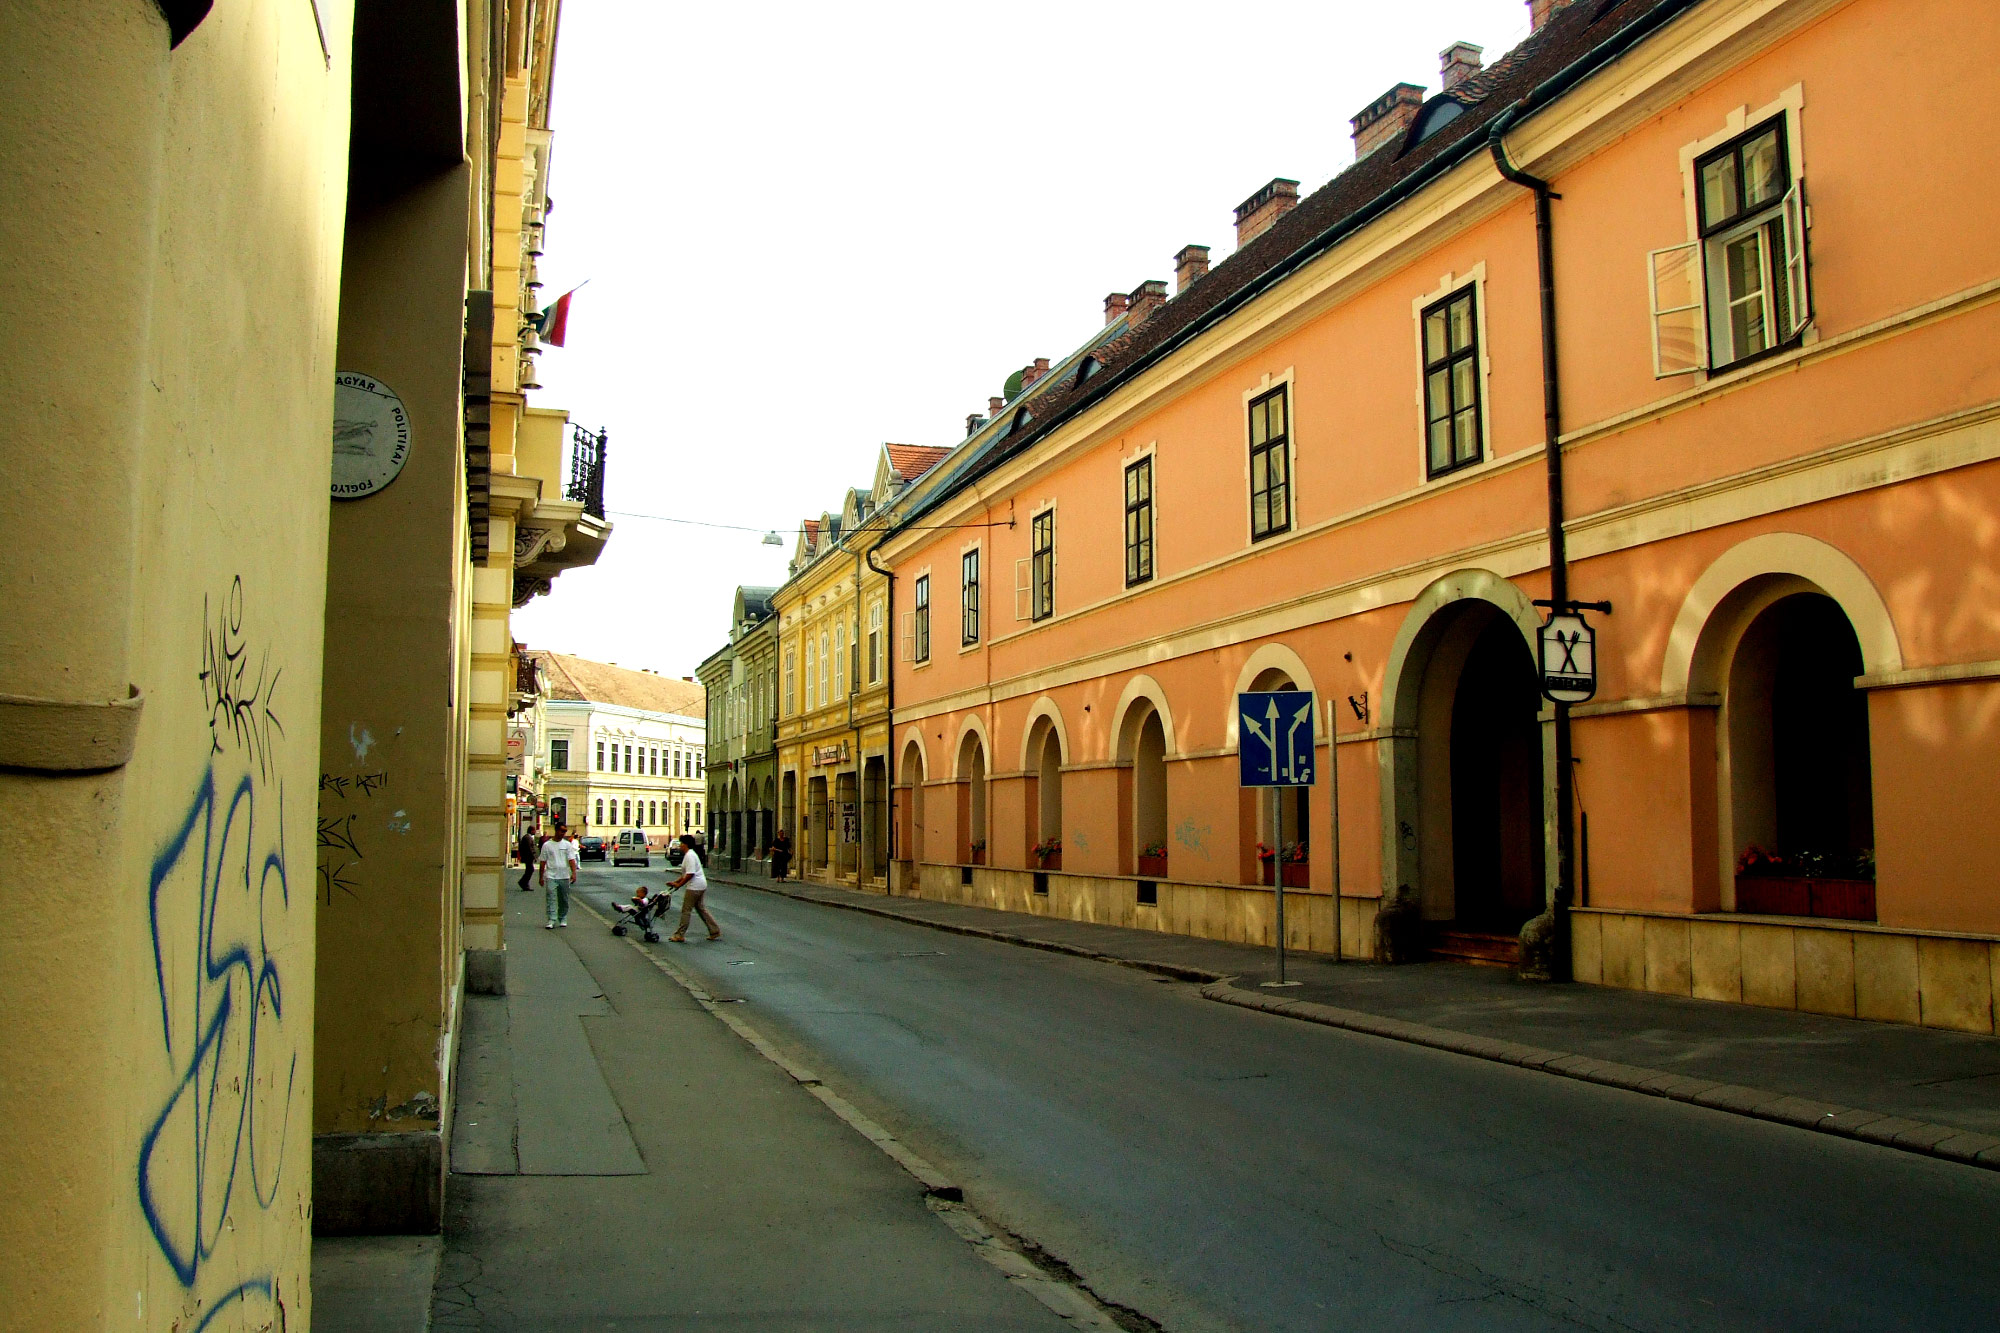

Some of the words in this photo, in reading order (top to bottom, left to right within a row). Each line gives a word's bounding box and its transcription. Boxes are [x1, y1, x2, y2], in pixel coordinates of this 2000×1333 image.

[335, 376, 376, 392] AGYAR
[391, 407, 407, 465] POLITIKAI
[330, 479, 374, 493] FOGLYO
